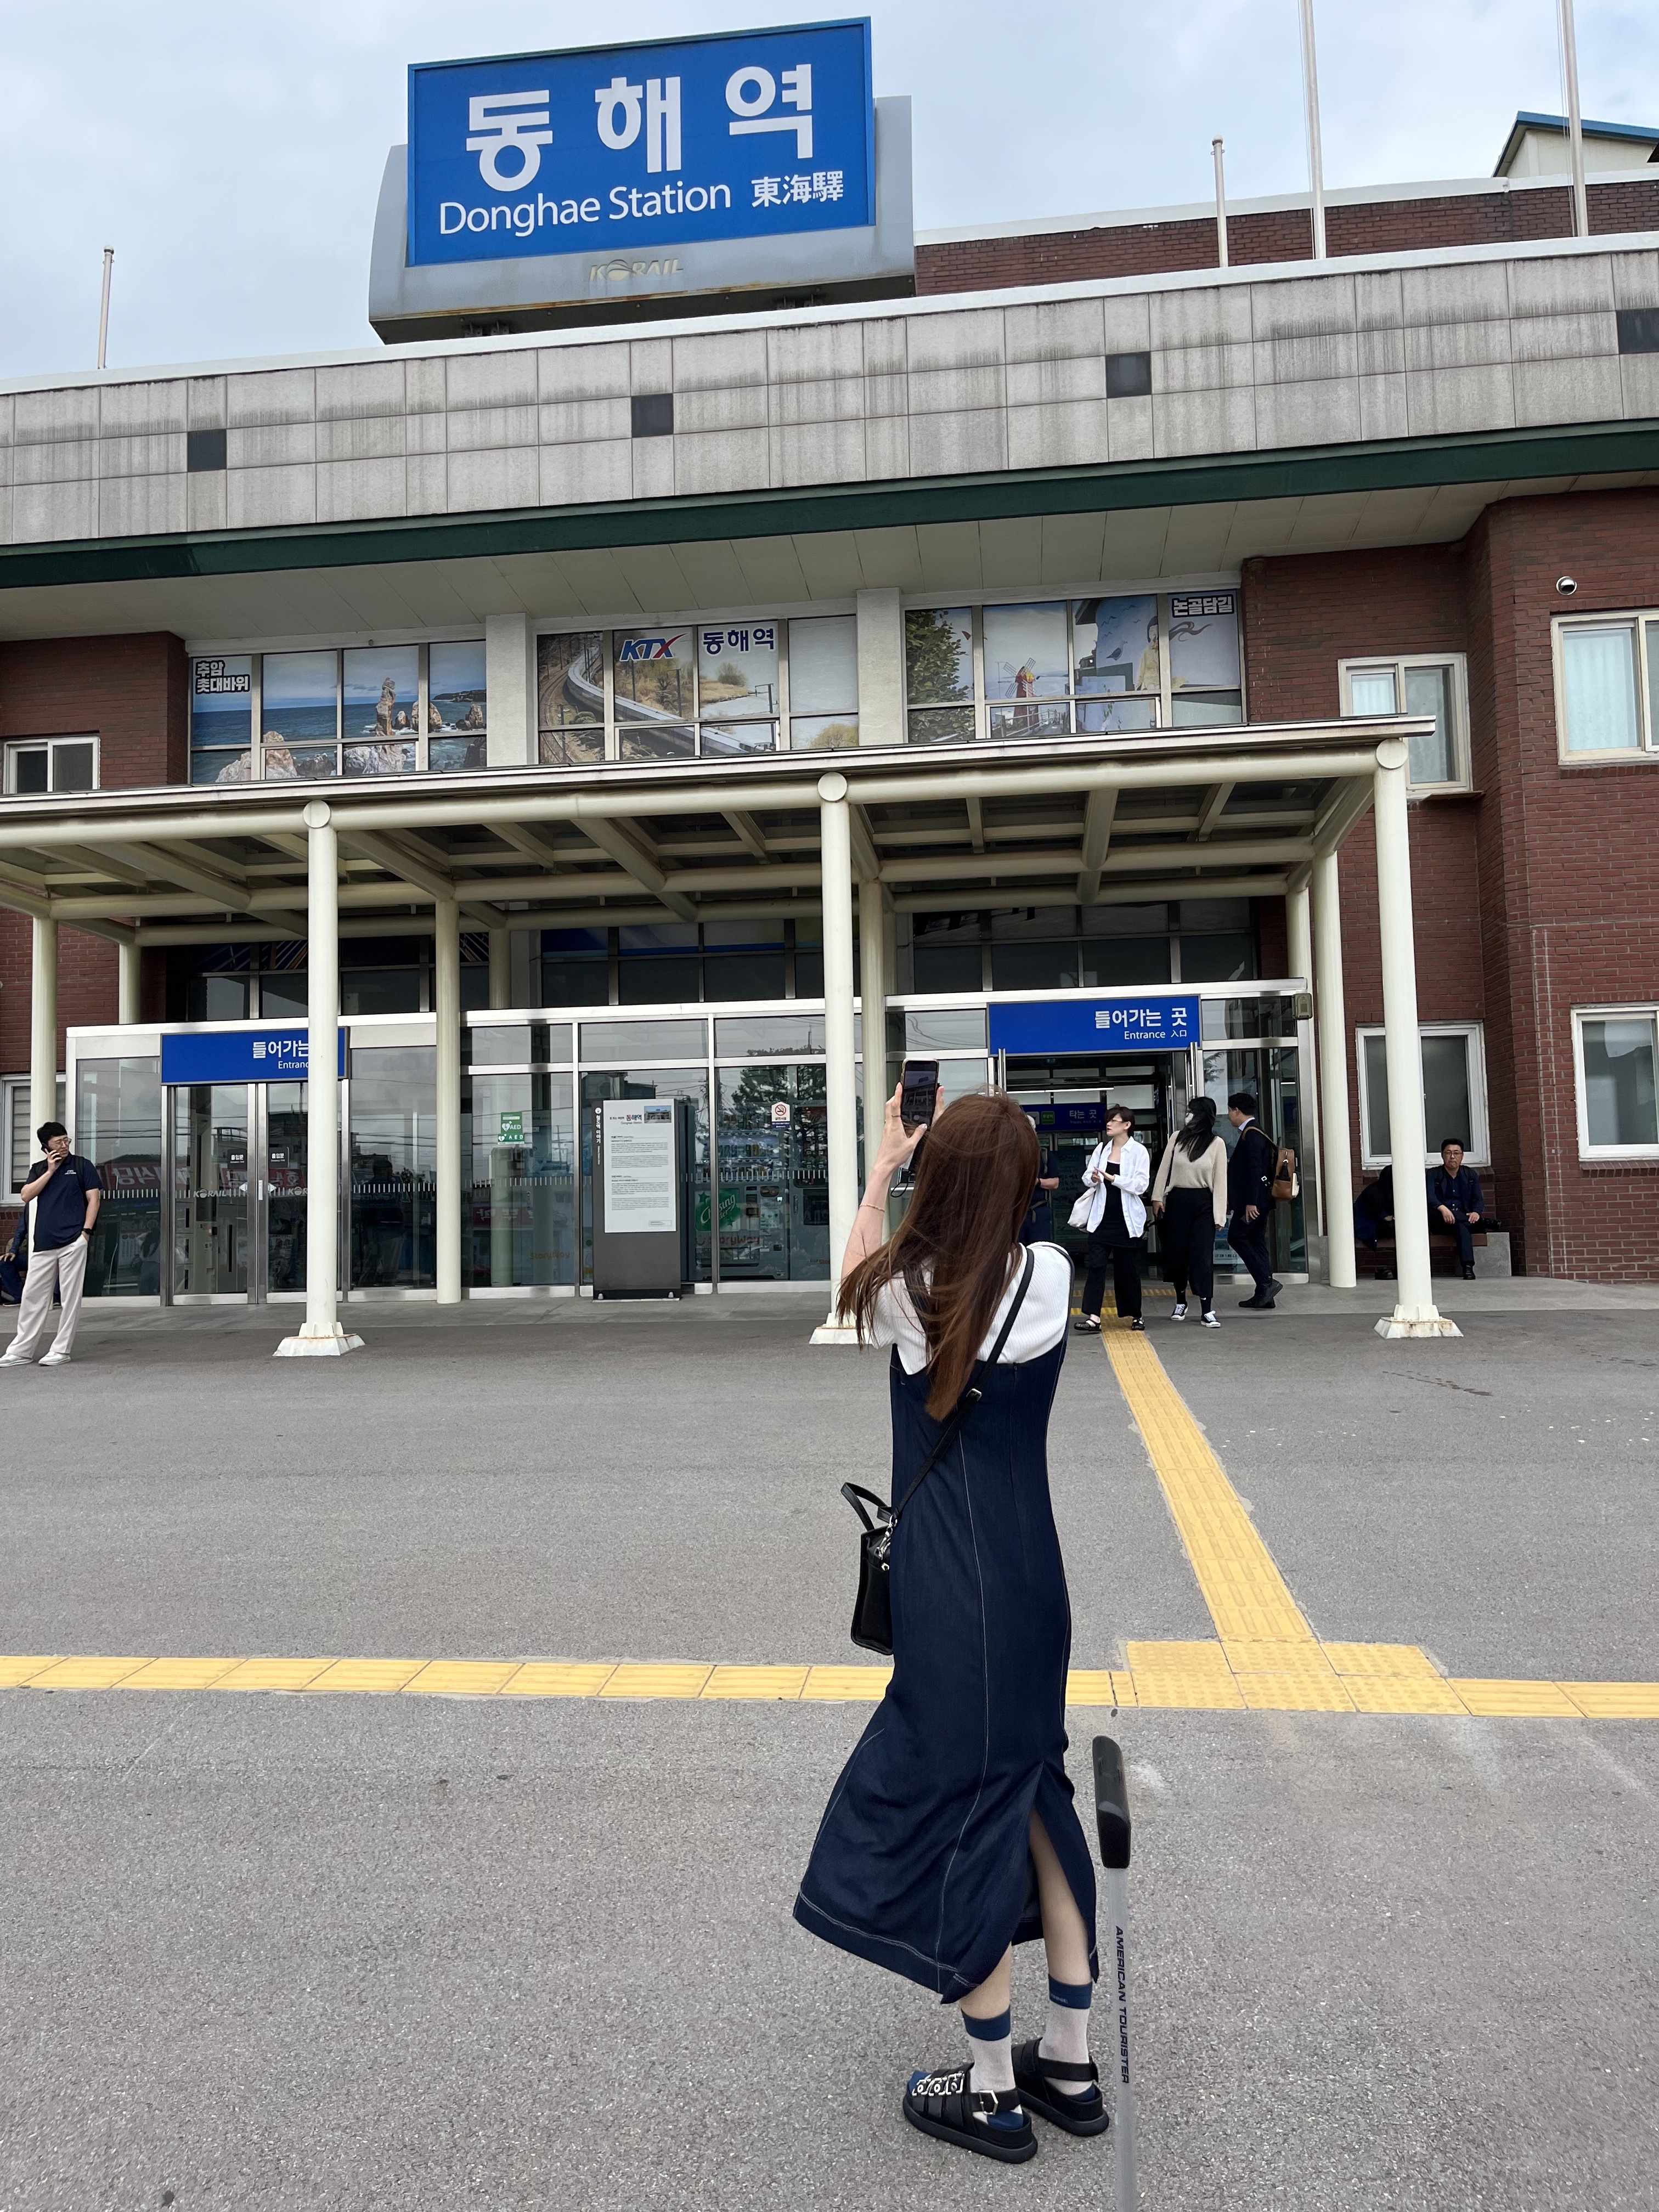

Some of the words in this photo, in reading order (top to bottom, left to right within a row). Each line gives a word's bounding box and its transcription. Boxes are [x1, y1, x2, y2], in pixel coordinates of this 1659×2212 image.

[466, 63, 813, 192] 동해역
[751, 170, 844, 208] 東海驛
[440, 193, 601, 237] Donghae
[609, 181, 731, 219] Station
[589, 258, 684, 281] KORAIL
[1173, 595, 1233, 617] 논골담길
[619, 632, 689, 662] KTX
[703, 628, 774, 655] 동해역
[196, 661, 225, 676] 추암
[196, 675, 249, 693] 촛대바위
[1095, 1009, 1161, 1029] 들어가는
[1171, 1007, 1187, 1026] 곳
[1124, 1031, 1166, 1040] Entrance
[278, 1060, 308, 1069] Entranc
[1069, 1110, 1085, 1119] 타는
[1089, 1109, 1097, 1119] 곳
[193, 1189, 227, 1199] KORAIL
[1115, 1925, 1126, 2002] AMERICAN
[1119, 2007, 1129, 2084] TOURISTER
